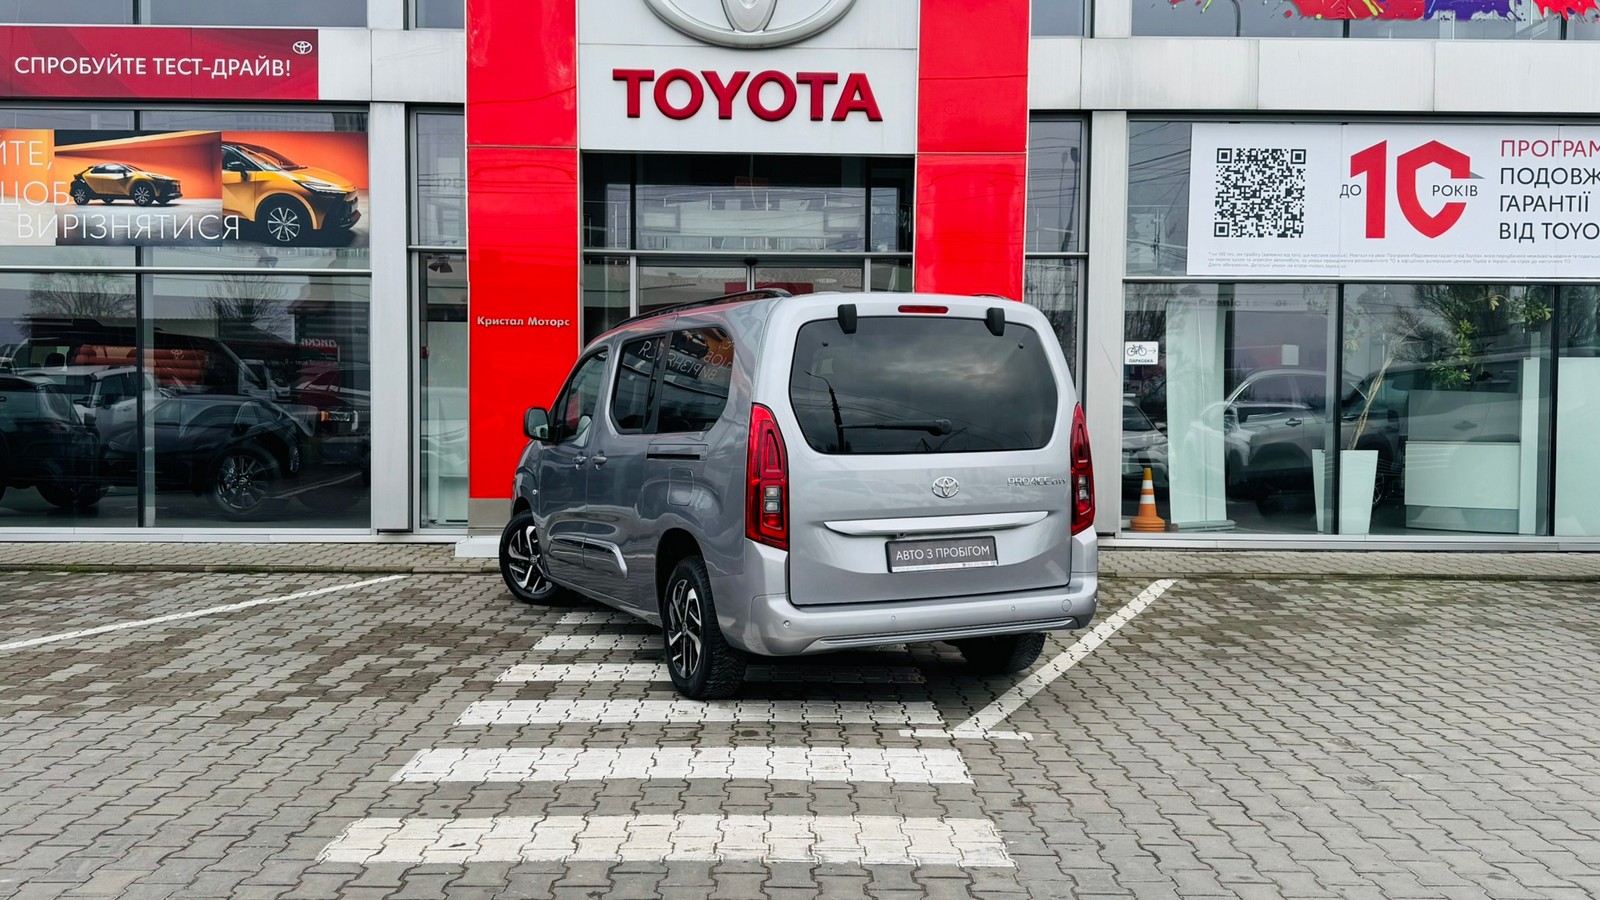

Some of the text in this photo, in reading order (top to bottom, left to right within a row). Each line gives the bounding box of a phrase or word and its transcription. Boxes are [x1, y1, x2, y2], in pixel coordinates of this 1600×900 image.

[14, 53, 291, 79] СПРОБУЙТЕ ТЕСТ-ДРАЙВ!
[612, 68, 883, 122] TOYOTA
[1499, 167, 1600, 189] ПОДОВЖ
[1339, 184, 1362, 199] ДО
[1432, 184, 1478, 197] РОКІВ
[1499, 191, 1591, 213] ГАРАНТІЇ
[17, 213, 240, 240] ВИРІЗНЯТИСЯ
[1499, 222, 1600, 243] ВІД TOYO
[477, 316, 571, 328] Кристал Моторс
[1007, 476, 1051, 487] PROACE
[895, 549, 924, 561] АВТО
[936, 545, 990, 558] ПРОБІГОМ
